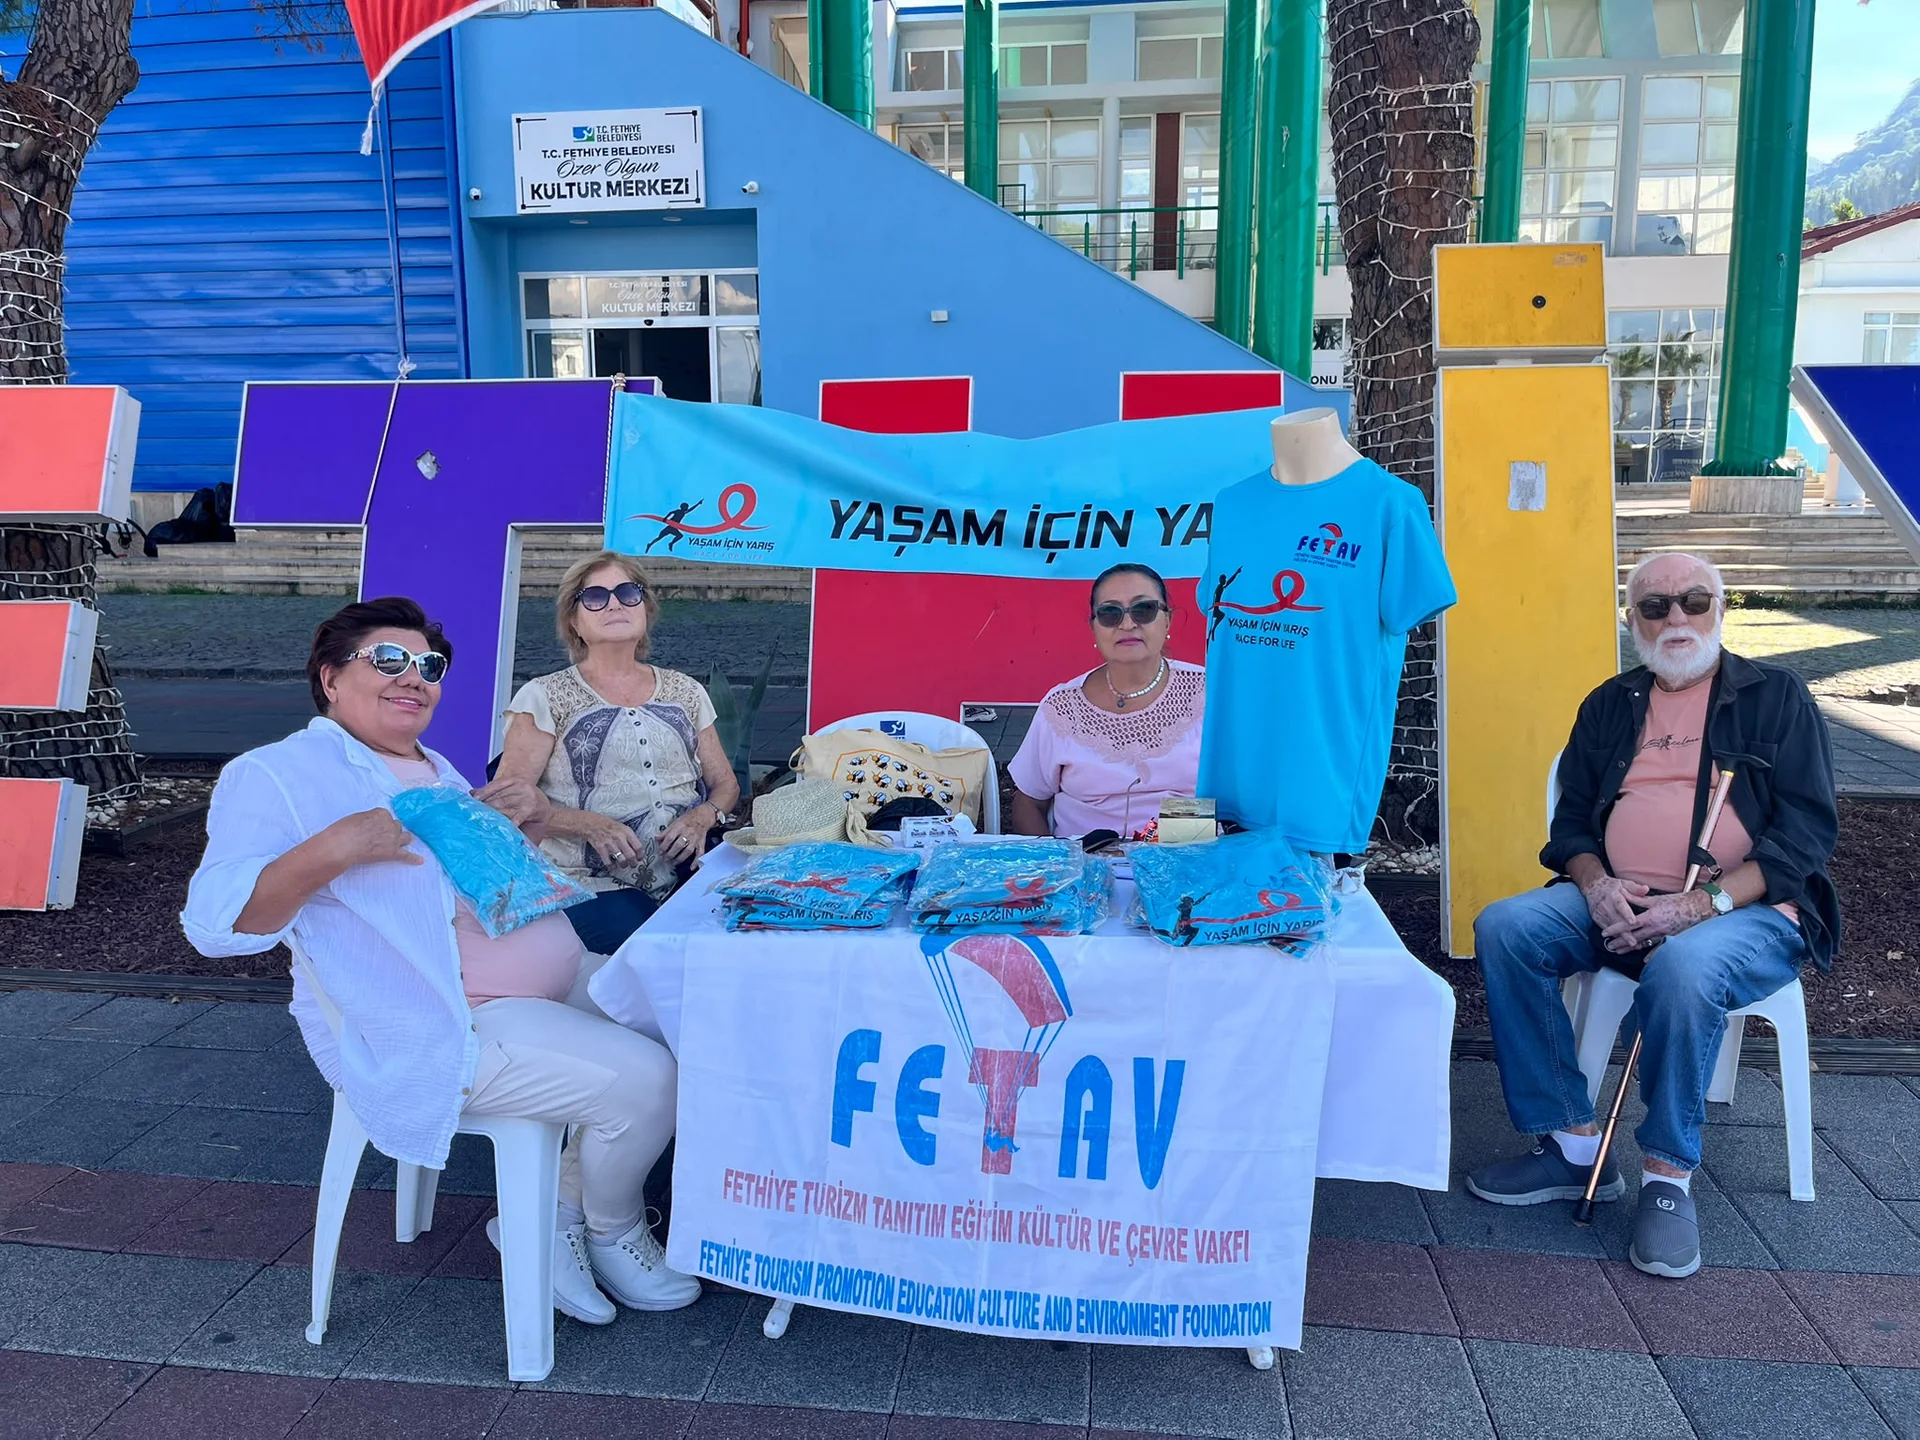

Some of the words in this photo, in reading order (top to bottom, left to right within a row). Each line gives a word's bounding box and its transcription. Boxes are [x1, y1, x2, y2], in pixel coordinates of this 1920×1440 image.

[596, 132, 642, 142] BELEDİYESİ
[541, 149, 561, 159] T.C.
[604, 157, 660, 179] Olgun
[606, 178, 689, 197] MERKEZİ
[830, 499, 1005, 558] YAŞAM
[1022, 501, 1132, 565] İÇİN
[688, 537, 722, 549] YAŞAM
[723, 537, 744, 551] İÇİN
[746, 540, 776, 553] YARIŞ
[1297, 535, 1362, 562] FETAV
[1228, 617, 1259, 631] YAŞAM
[1260, 618, 1282, 633] İÇİN
[1283, 623, 1310, 638] YARIŞ
[1235, 633, 1257, 645] RACE
[1258, 636, 1280, 647] FOR
[1204, 925, 1250, 941] YAŞAM
[1253, 921, 1281, 937] İÇİN
[831, 1028, 1186, 1191] FETAV
[723, 1168, 798, 1213] FETHİYE
[803, 1180, 868, 1225] TURİZM
[873, 1195, 948, 1238] TANITIM
[951, 1198, 1013, 1244] EĞİTİM
[1018, 1204, 1093, 1253] KÜLTÜR
[1098, 1218, 1122, 1257] VE
[1126, 1222, 1188, 1267] ÇEVRE
[1194, 1228, 1250, 1264] VAKFI
[699, 1237, 752, 1285] FETHİYE
[754, 1252, 815, 1297] TOURISM
[813, 1262, 897, 1311] PROMOTION
[896, 1277, 976, 1326] EDUCATION
[977, 1288, 1041, 1331] CULTURE
[1043, 1293, 1073, 1333] AND
[1076, 1297, 1180, 1338] ENVIRONMENT
[1182, 1300, 1273, 1338] FOUNDATION
